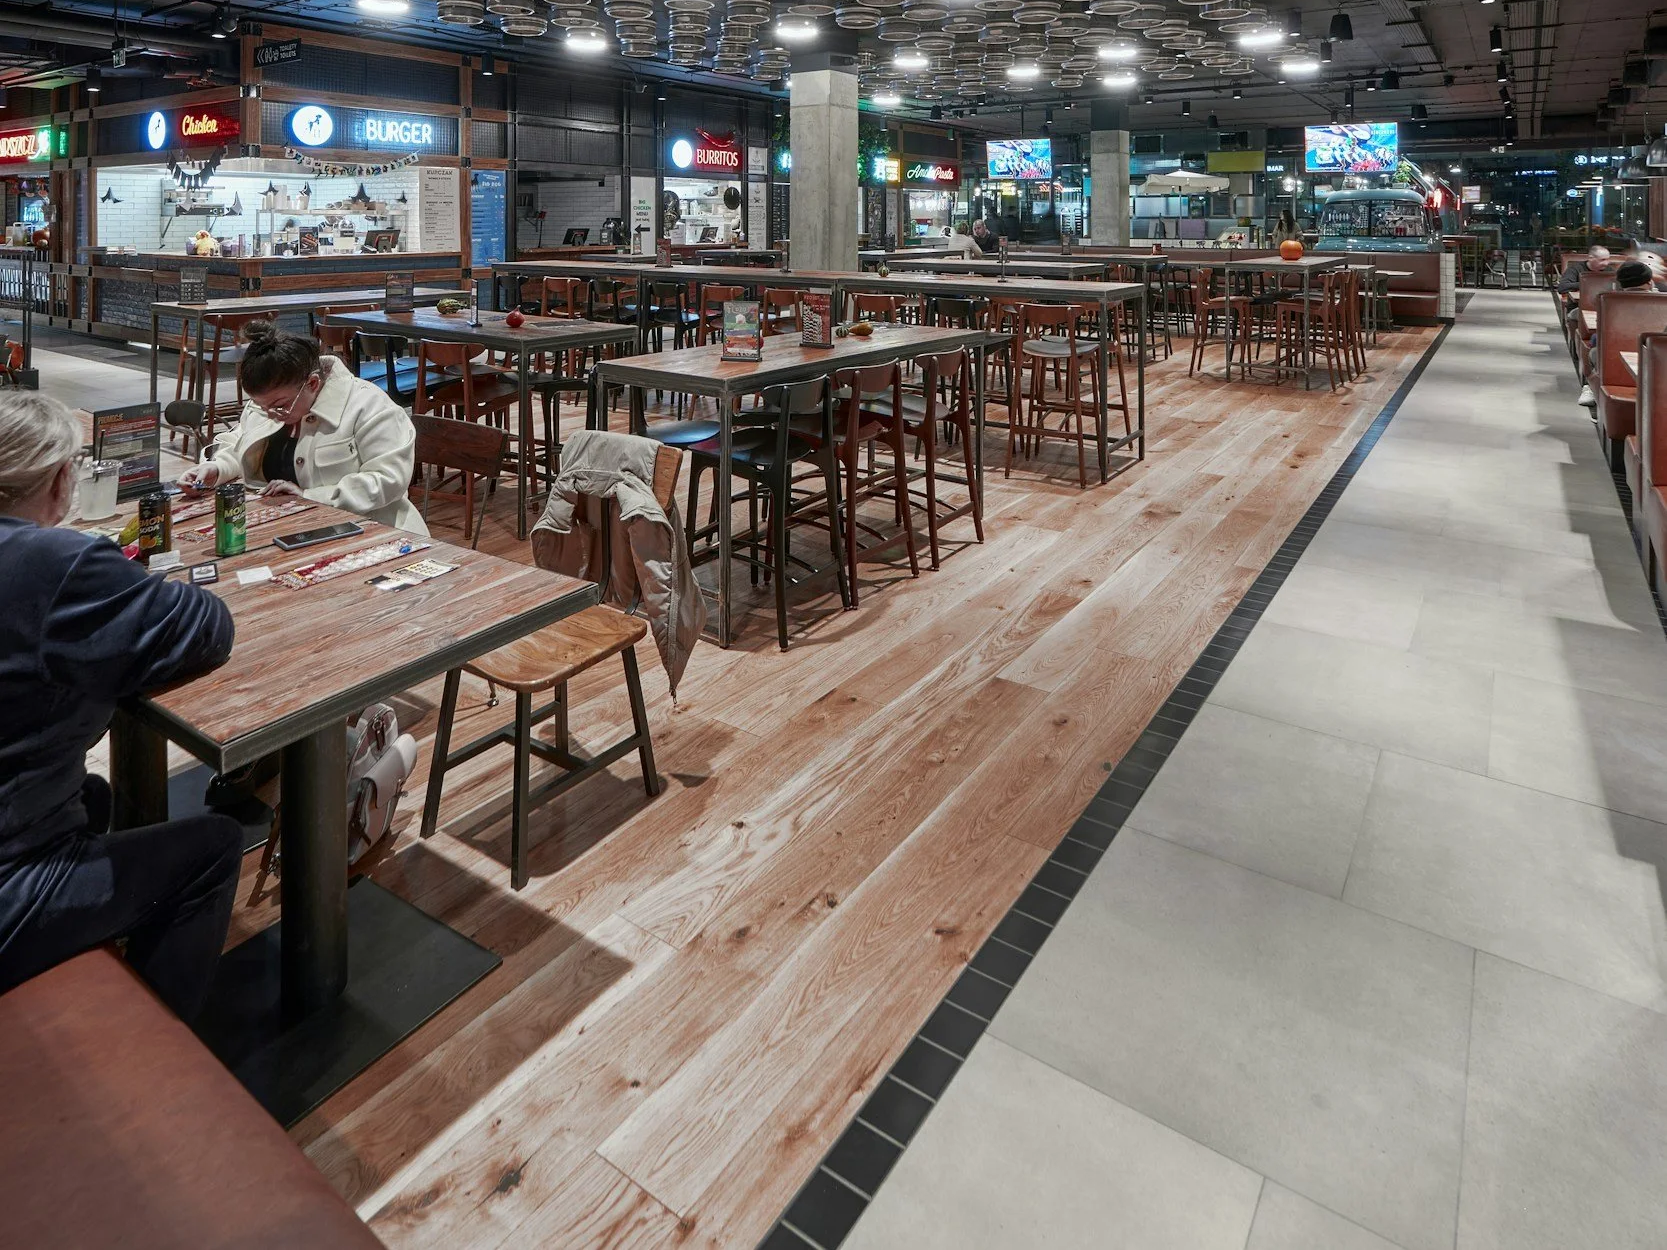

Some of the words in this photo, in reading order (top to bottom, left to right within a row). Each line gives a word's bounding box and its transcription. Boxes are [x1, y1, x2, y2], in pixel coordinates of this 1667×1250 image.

[182, 114, 218, 136] Chicken
[366, 119, 432, 144] BURGER
[696, 149, 739, 167] BURRITOS
